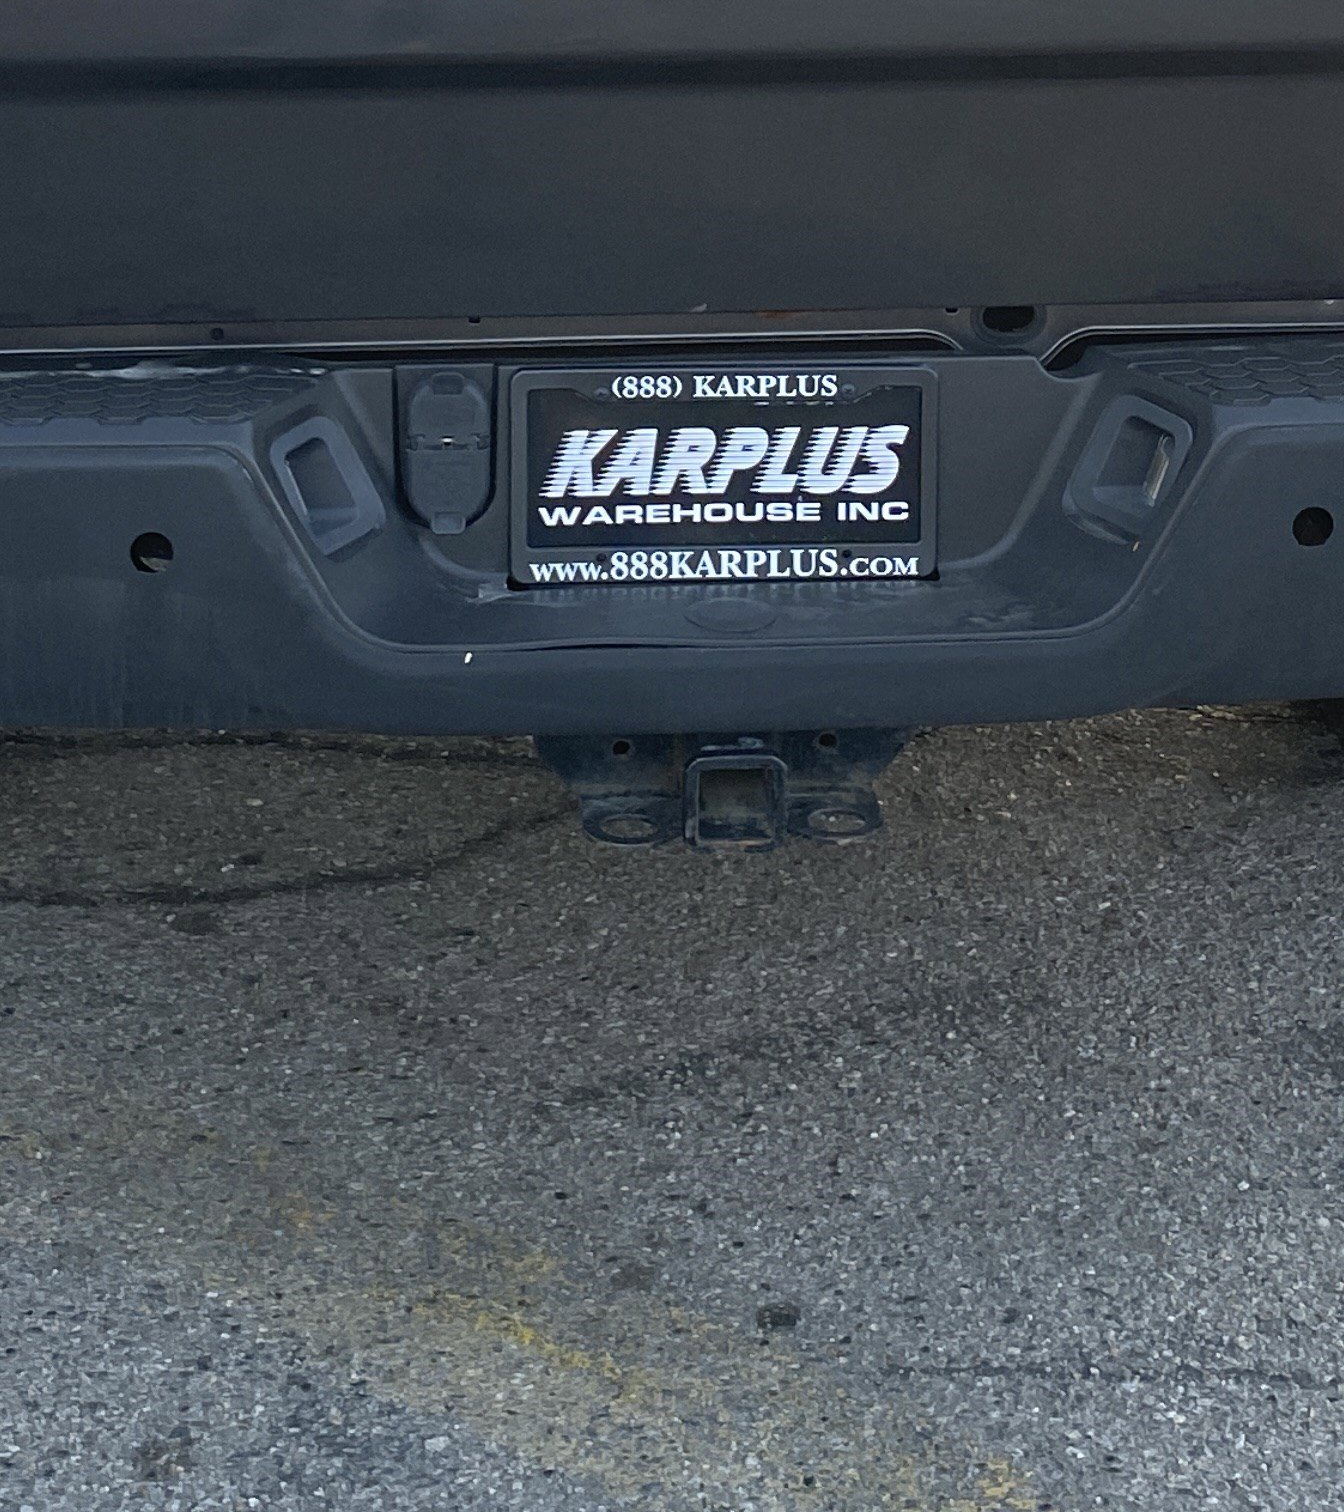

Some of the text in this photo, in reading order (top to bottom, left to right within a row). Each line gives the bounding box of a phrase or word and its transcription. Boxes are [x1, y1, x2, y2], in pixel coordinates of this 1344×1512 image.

[611, 374, 838, 400] (888) KARPLUS
[538, 424, 910, 499] KARPLUS
[537, 500, 910, 527] WAREHOUSE INC
